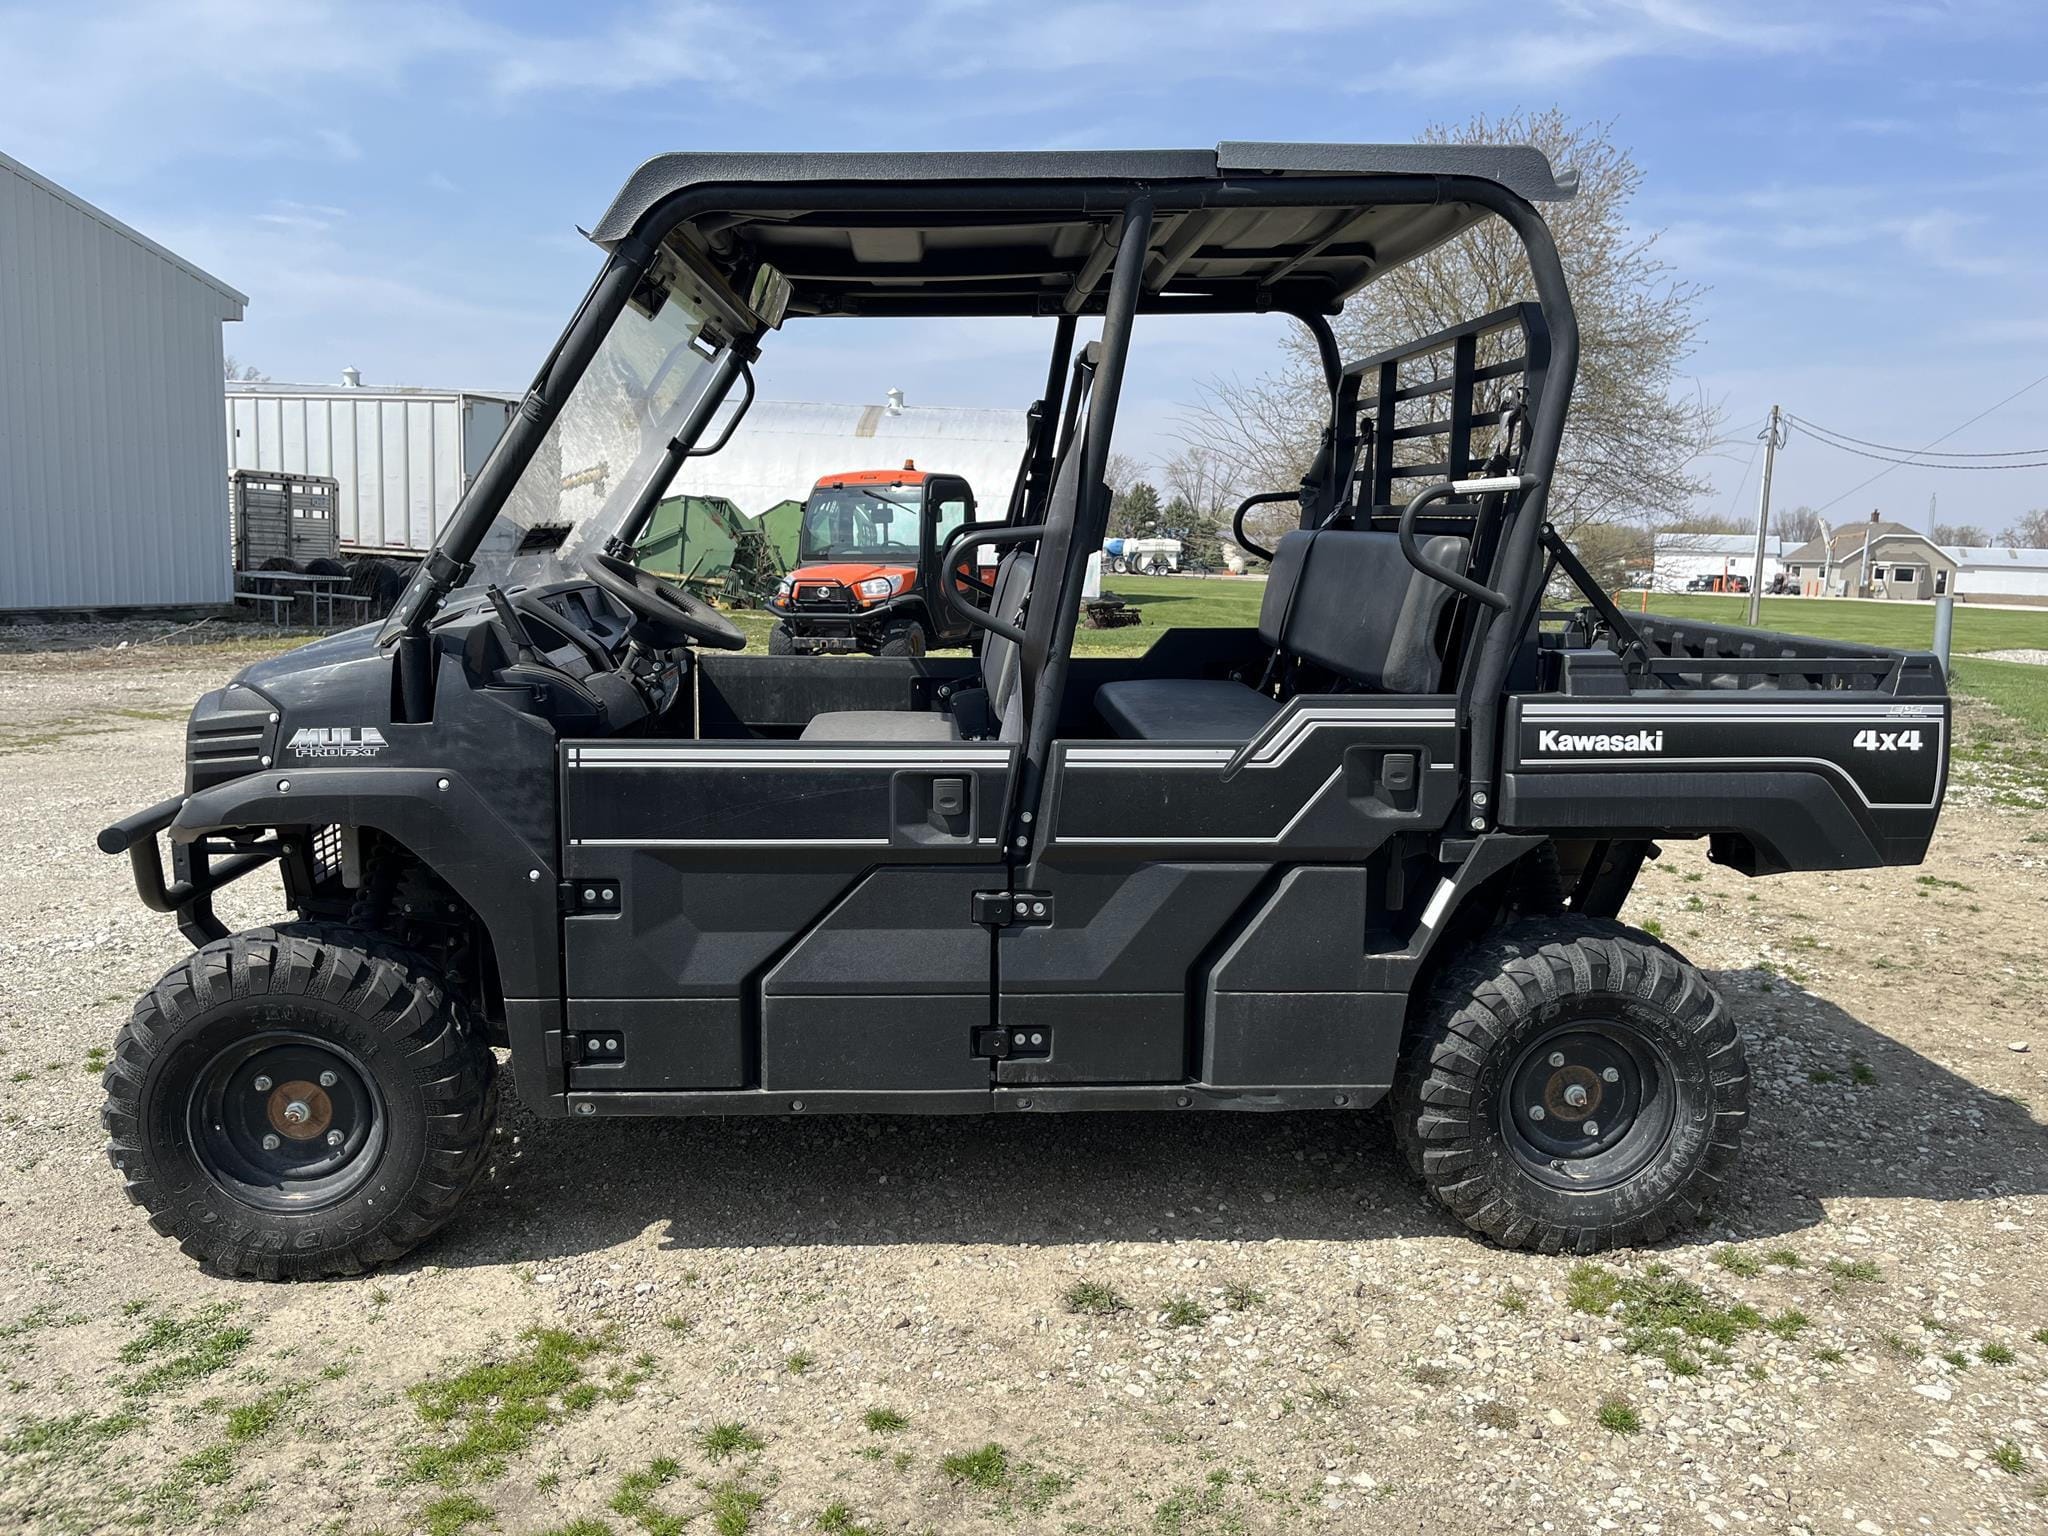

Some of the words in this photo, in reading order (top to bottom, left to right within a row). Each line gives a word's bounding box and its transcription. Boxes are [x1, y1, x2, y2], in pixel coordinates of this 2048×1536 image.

[286, 727, 389, 749] MULE
[1539, 730, 1663, 751] Kawasaki
[1853, 730, 1923, 751] 4x4
